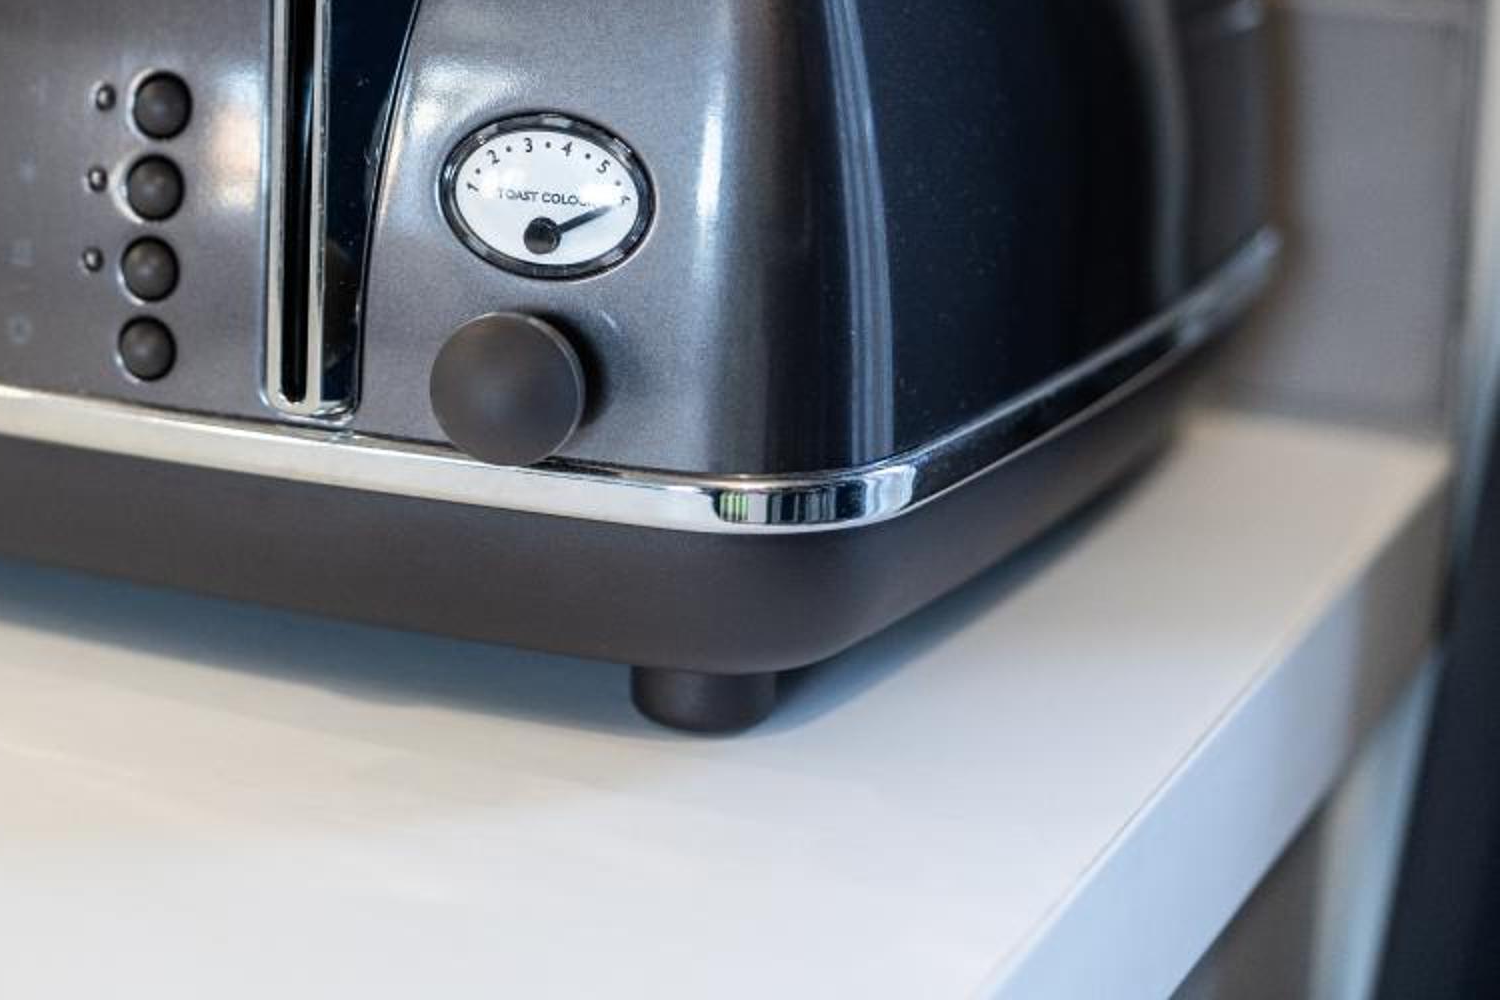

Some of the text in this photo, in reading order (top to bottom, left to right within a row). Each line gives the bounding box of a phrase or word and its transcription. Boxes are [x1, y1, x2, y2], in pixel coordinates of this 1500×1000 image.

[486, 149, 501, 165] 2
[523, 137, 533, 153] 3
[561, 140, 573, 156] 4
[596, 159, 611, 174] 5
[541, 192, 597, 208] COLO
